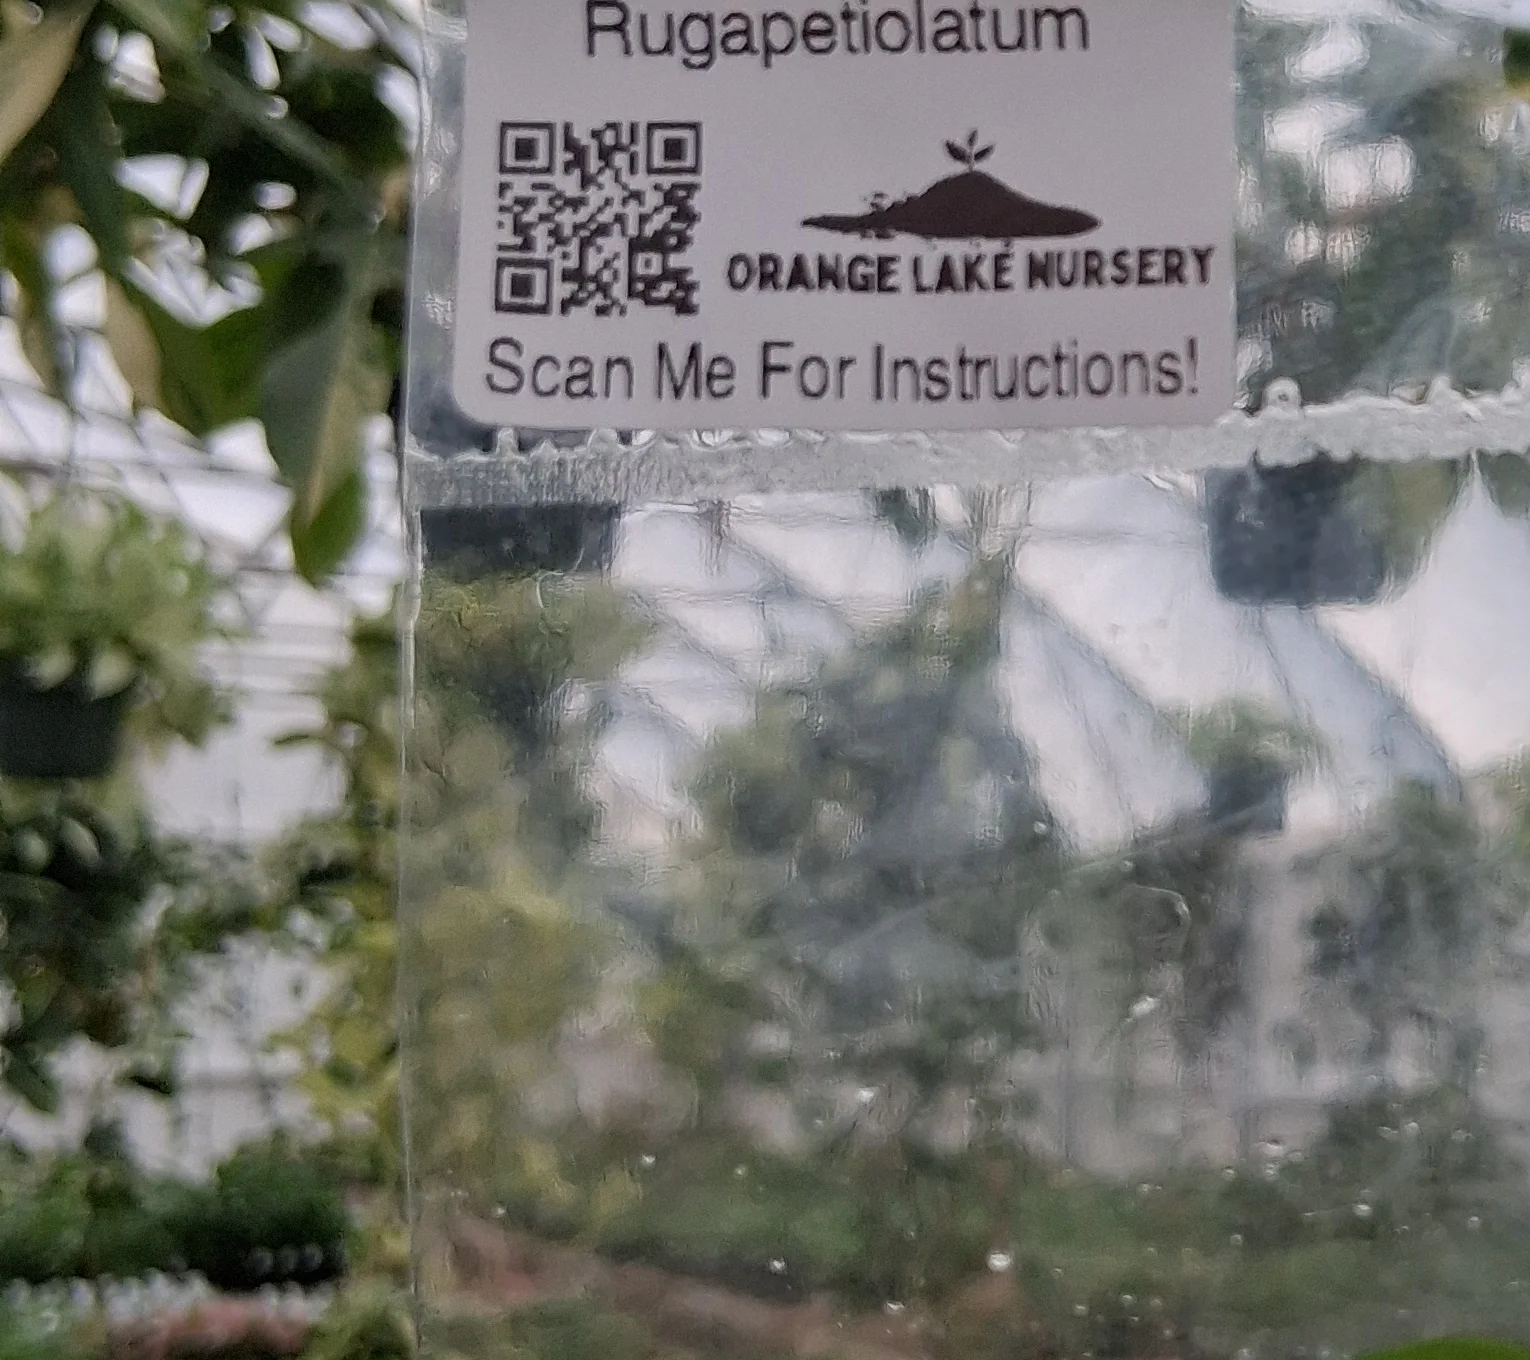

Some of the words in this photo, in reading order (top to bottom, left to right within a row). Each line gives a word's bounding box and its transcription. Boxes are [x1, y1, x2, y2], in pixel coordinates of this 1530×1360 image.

[726, 251, 902, 295] ORANGE
[912, 250, 1017, 294] LAKE
[1027, 245, 1216, 290] NURSERY
[485, 336, 634, 401] Scan
[655, 341, 736, 402] Me
[759, 339, 858, 401] For
[872, 337, 1200, 403] Instructions!
